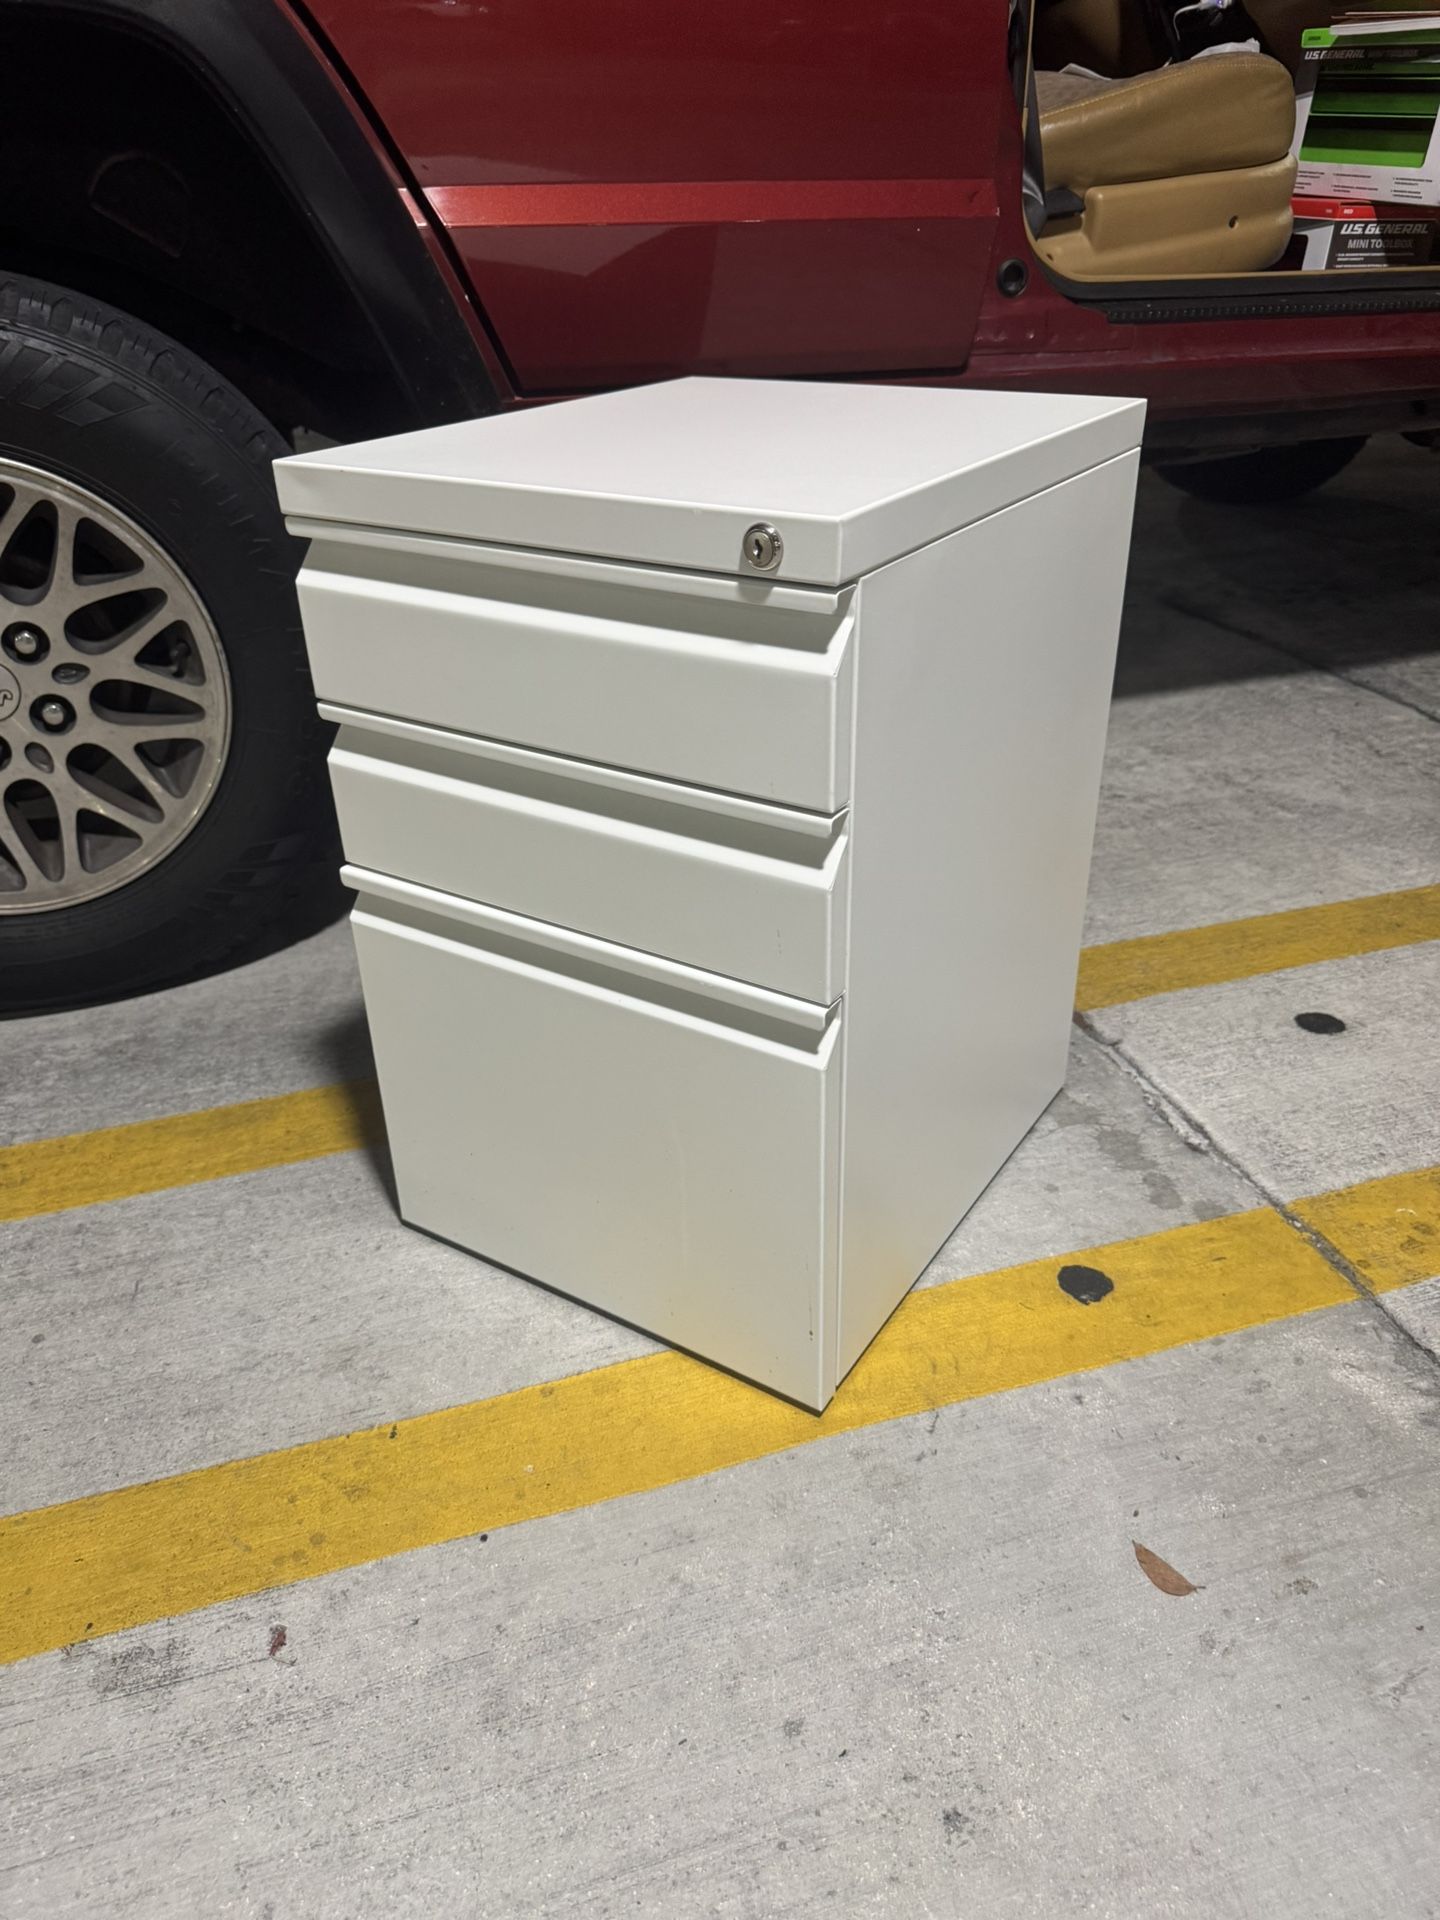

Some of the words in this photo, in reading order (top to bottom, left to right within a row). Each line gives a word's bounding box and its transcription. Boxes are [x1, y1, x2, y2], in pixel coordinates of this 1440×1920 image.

[1365, 223, 1429, 234] GENERAL
[1347, 239, 1369, 249] MINI
[1370, 239, 1413, 249] TOOLBOX
